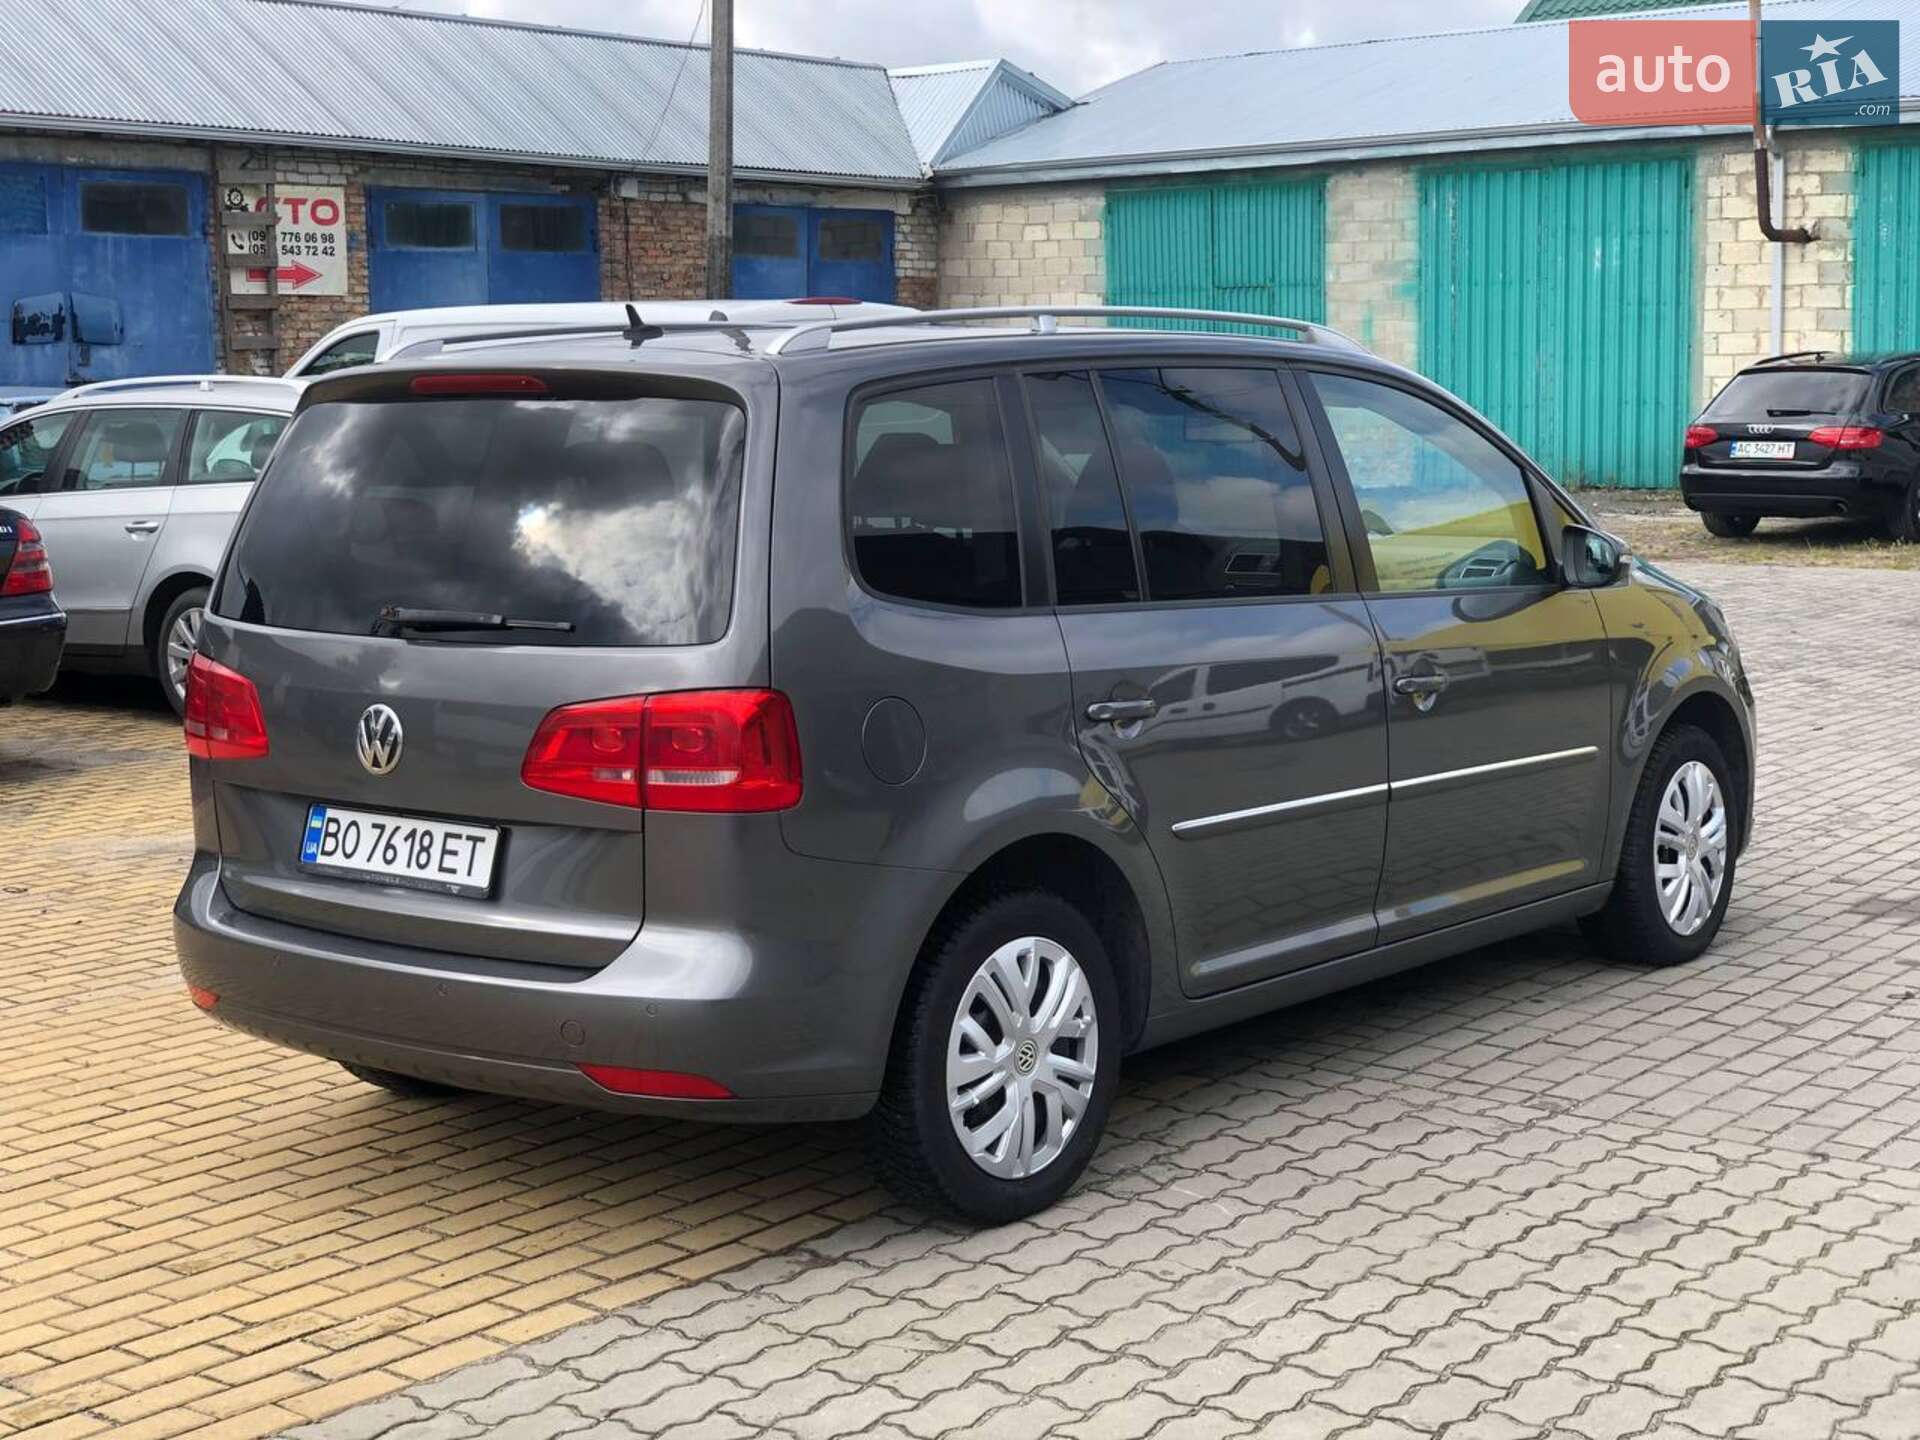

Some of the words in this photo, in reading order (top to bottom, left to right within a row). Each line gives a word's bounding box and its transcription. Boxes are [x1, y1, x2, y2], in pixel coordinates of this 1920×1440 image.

[280, 231, 301, 243] 776
[303, 231, 318, 243] 06
[320, 232, 335, 244] 98
[281, 244, 301, 256] 543
[303, 245, 319, 256] 72
[321, 245, 336, 257] 42
[305, 841, 318, 854] UA
[320, 816, 361, 860] BO
[366, 822, 434, 870] 7618
[437, 831, 486, 877] ET
